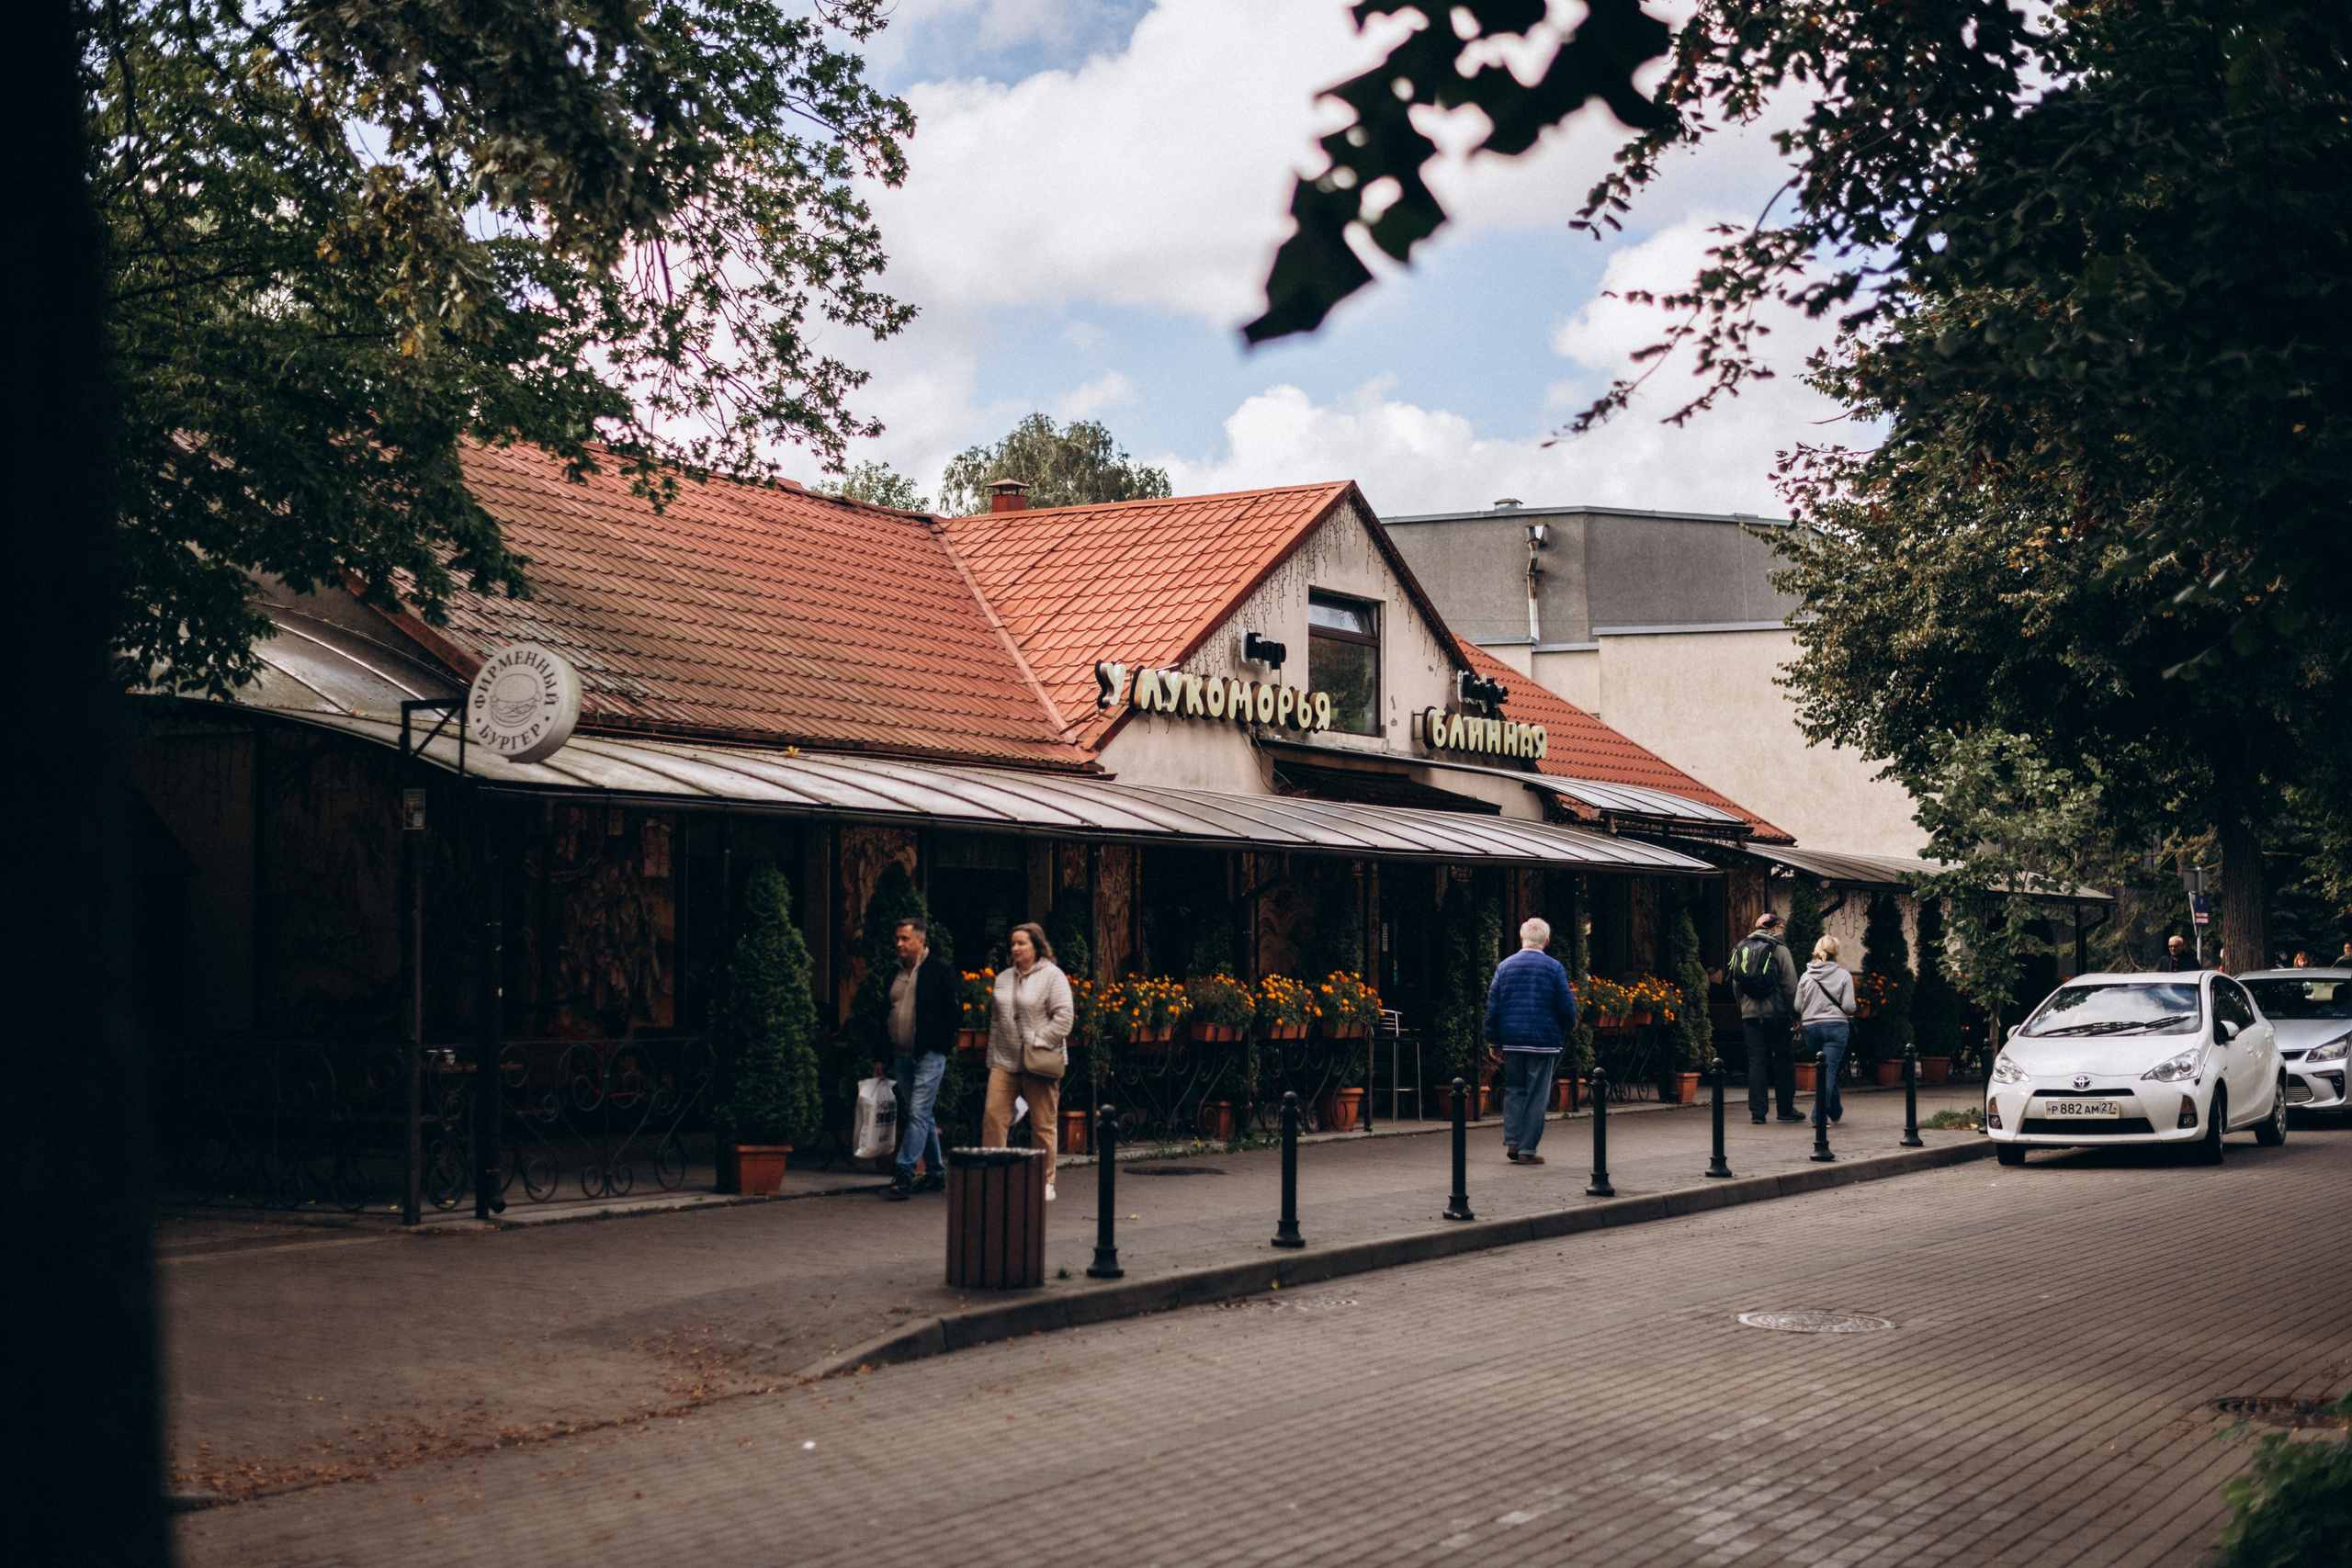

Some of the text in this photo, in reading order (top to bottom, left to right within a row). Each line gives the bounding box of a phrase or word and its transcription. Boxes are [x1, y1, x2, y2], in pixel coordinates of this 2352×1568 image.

[474, 650, 560, 709] ФИРМЕННЫЙ
[1097, 660, 1331, 731] У ЛУКОМОРЬЯ
[479, 723, 540, 750] БУРГЕР
[1430, 708, 1547, 760] БЛИННАЯ
